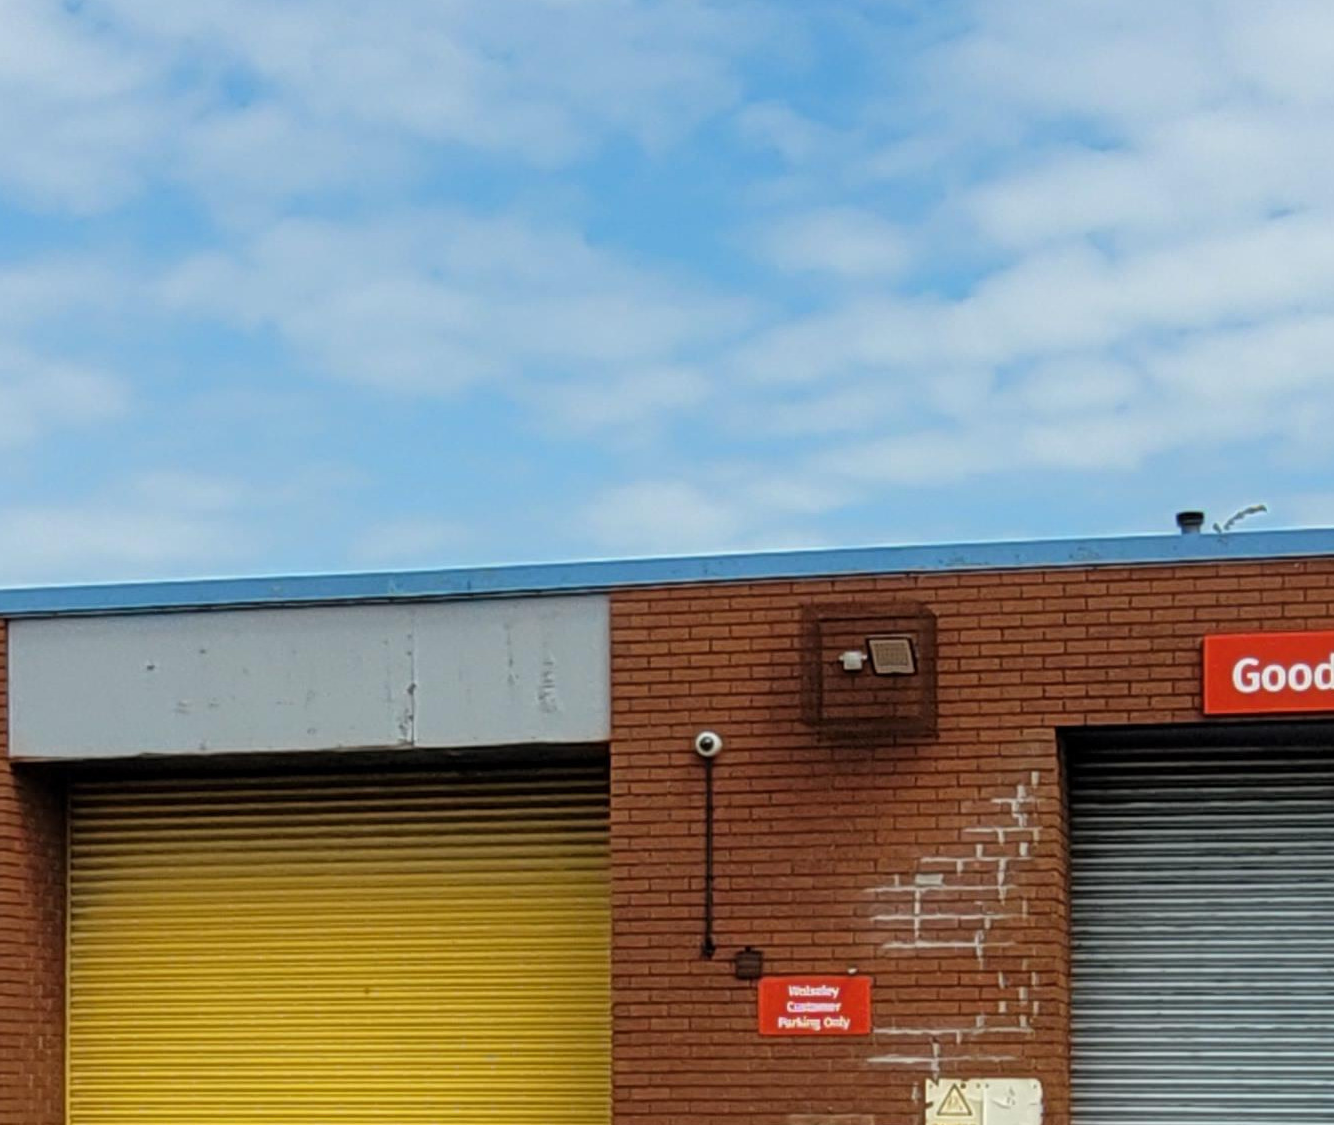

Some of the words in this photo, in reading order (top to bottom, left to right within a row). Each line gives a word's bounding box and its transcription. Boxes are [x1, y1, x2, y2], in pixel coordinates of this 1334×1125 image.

[788, 985, 839, 999] Wolseley
[786, 1001, 842, 1013] Customer
[778, 1017, 821, 1031] Parking
[823, 1016, 851, 1030] Only
